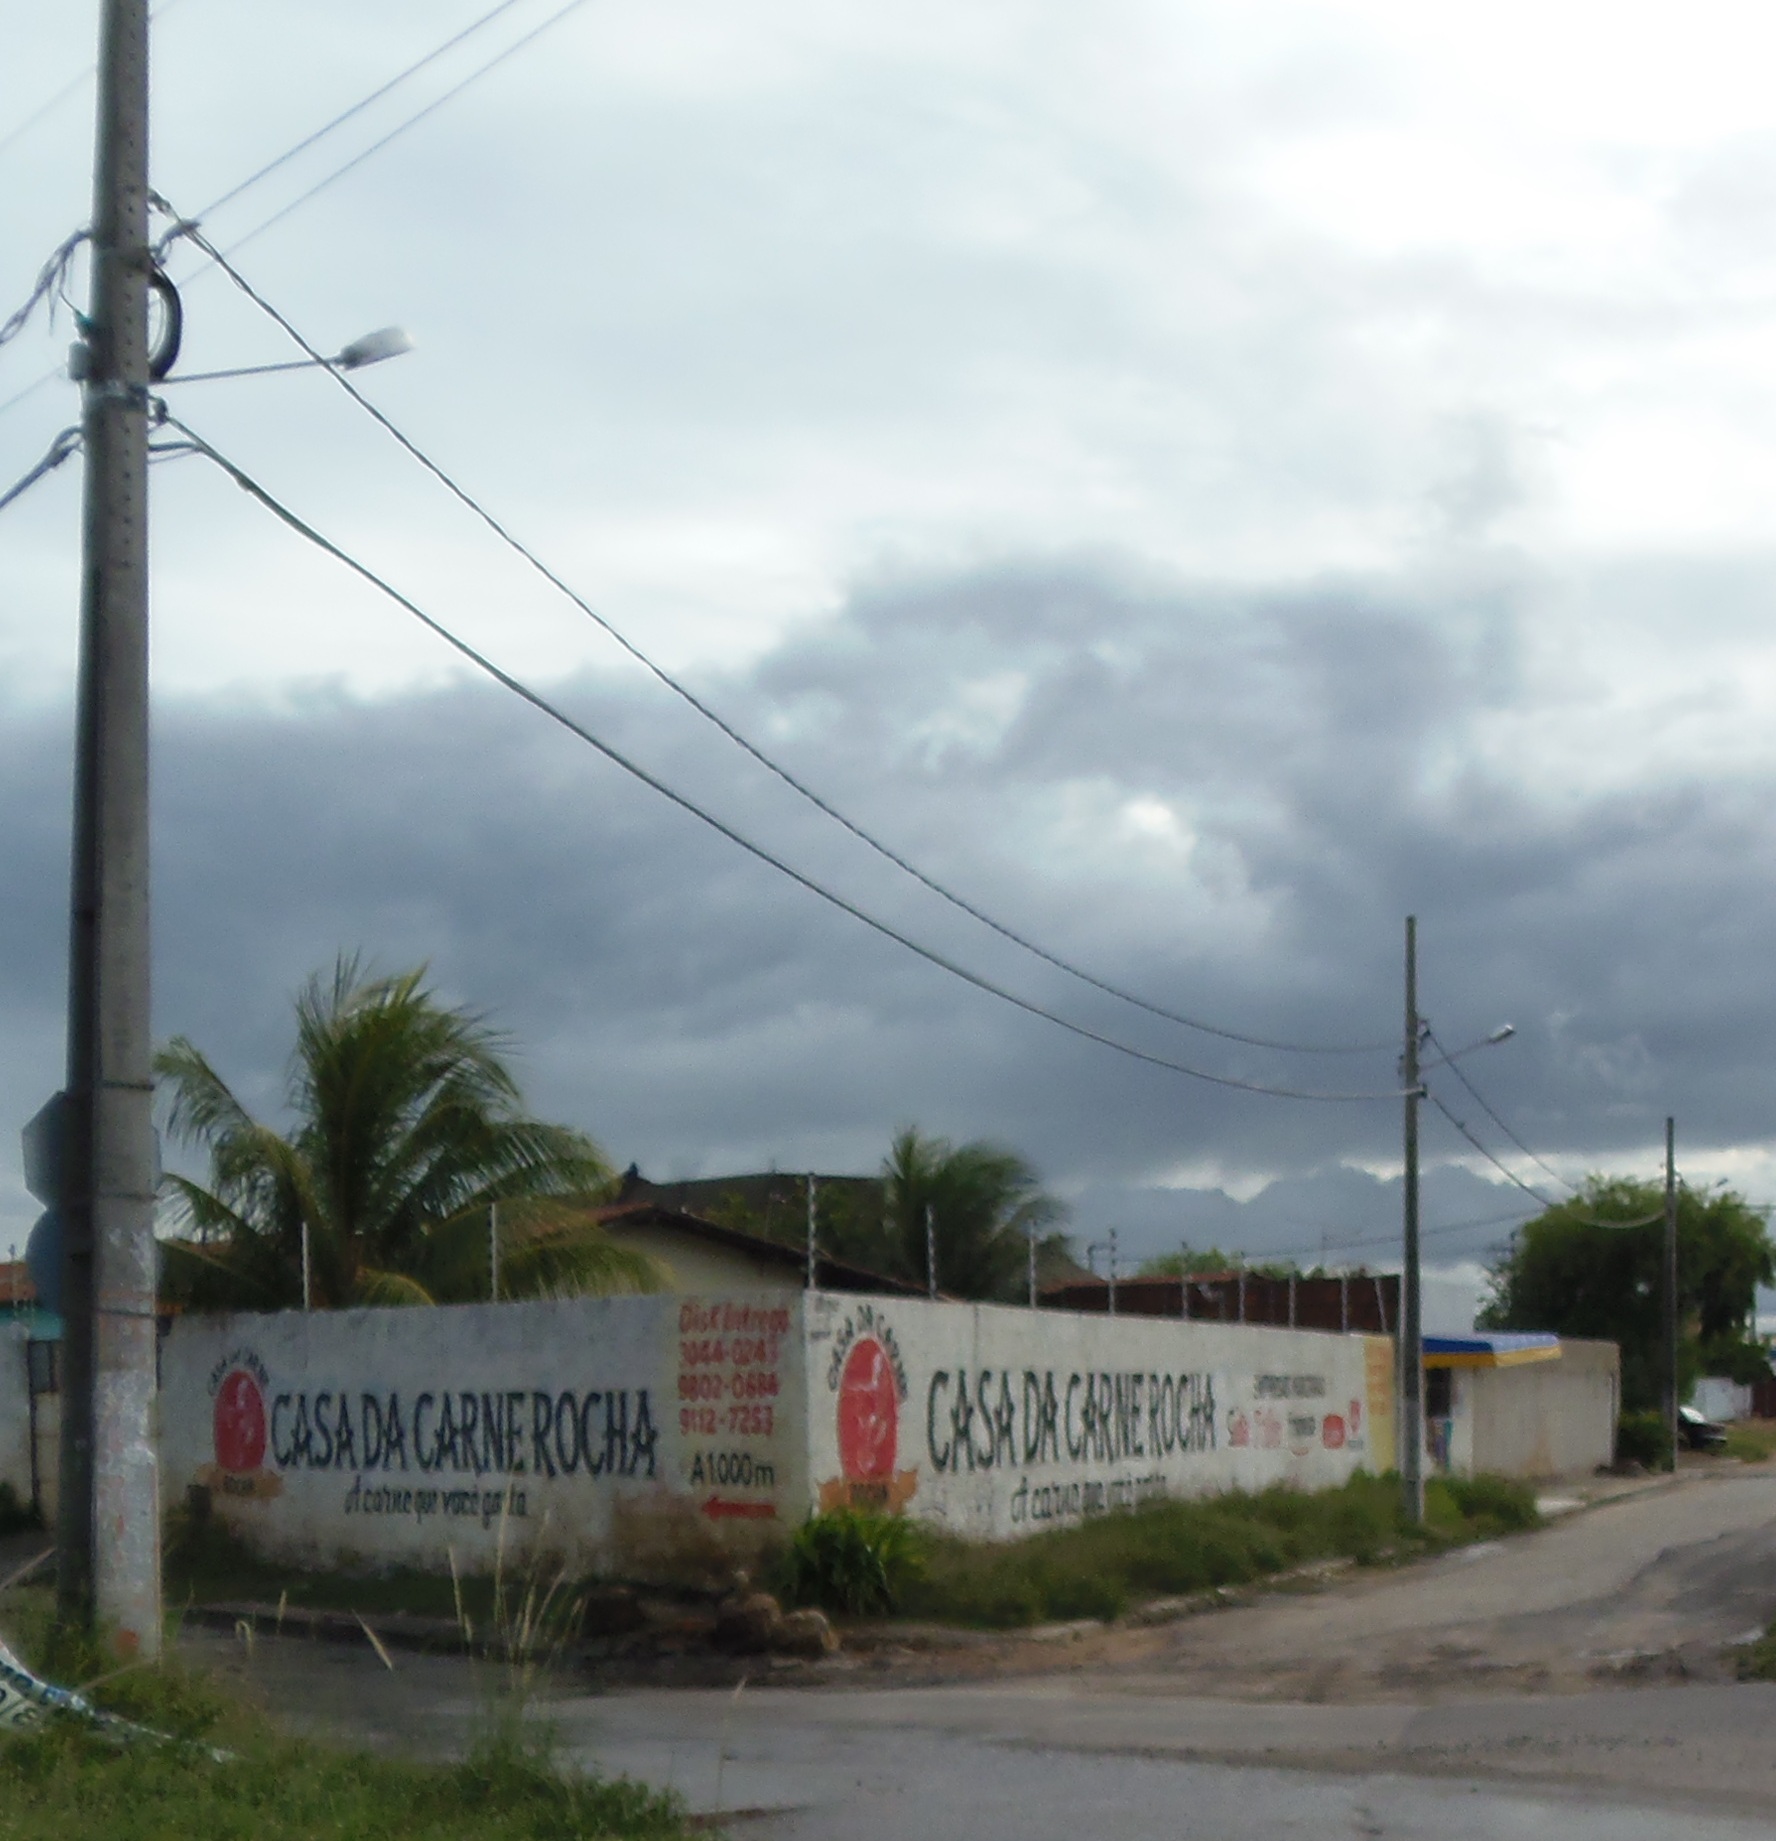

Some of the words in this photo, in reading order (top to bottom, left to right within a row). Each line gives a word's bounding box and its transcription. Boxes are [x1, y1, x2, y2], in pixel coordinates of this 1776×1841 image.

[271, 1391, 358, 1471] CASA
[360, 1391, 409, 1472] DA
[413, 1391, 528, 1478] CARNE
[530, 1390, 658, 1479] ROCHA
[927, 1369, 1017, 1474] CASA
[1022, 1370, 1059, 1464] DA
[1064, 1372, 1145, 1464] CARNE
[1148, 1372, 1217, 1457] ROCHA
